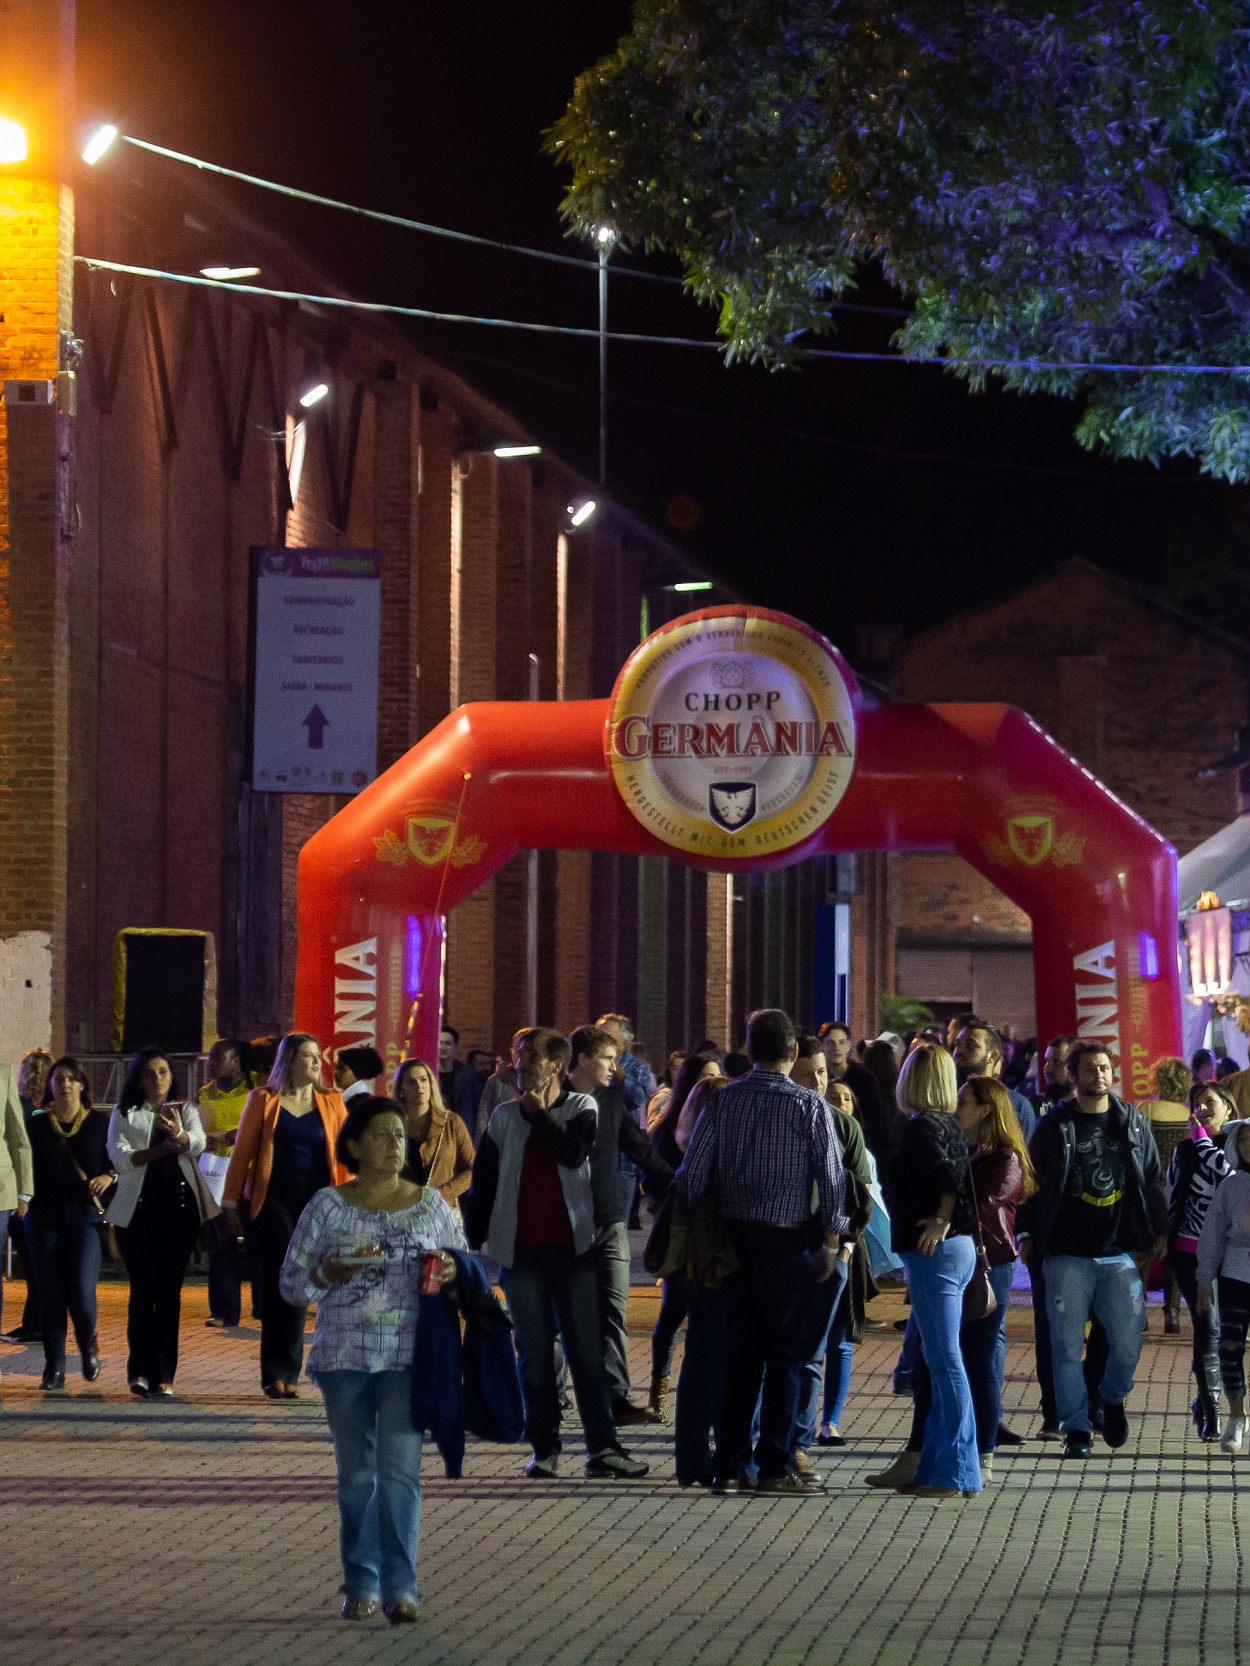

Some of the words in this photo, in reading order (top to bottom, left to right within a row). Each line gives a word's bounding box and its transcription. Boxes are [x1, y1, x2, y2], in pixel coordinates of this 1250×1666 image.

[684, 691, 781, 711] CHOPP
[613, 714, 852, 760] GERMÂNIA
[625, 774, 684, 837] HERGESTELLT
[720, 836, 746, 848] DEM
[755, 804, 819, 846] DEUTSCHEN
[815, 770, 839, 804] GEIST
